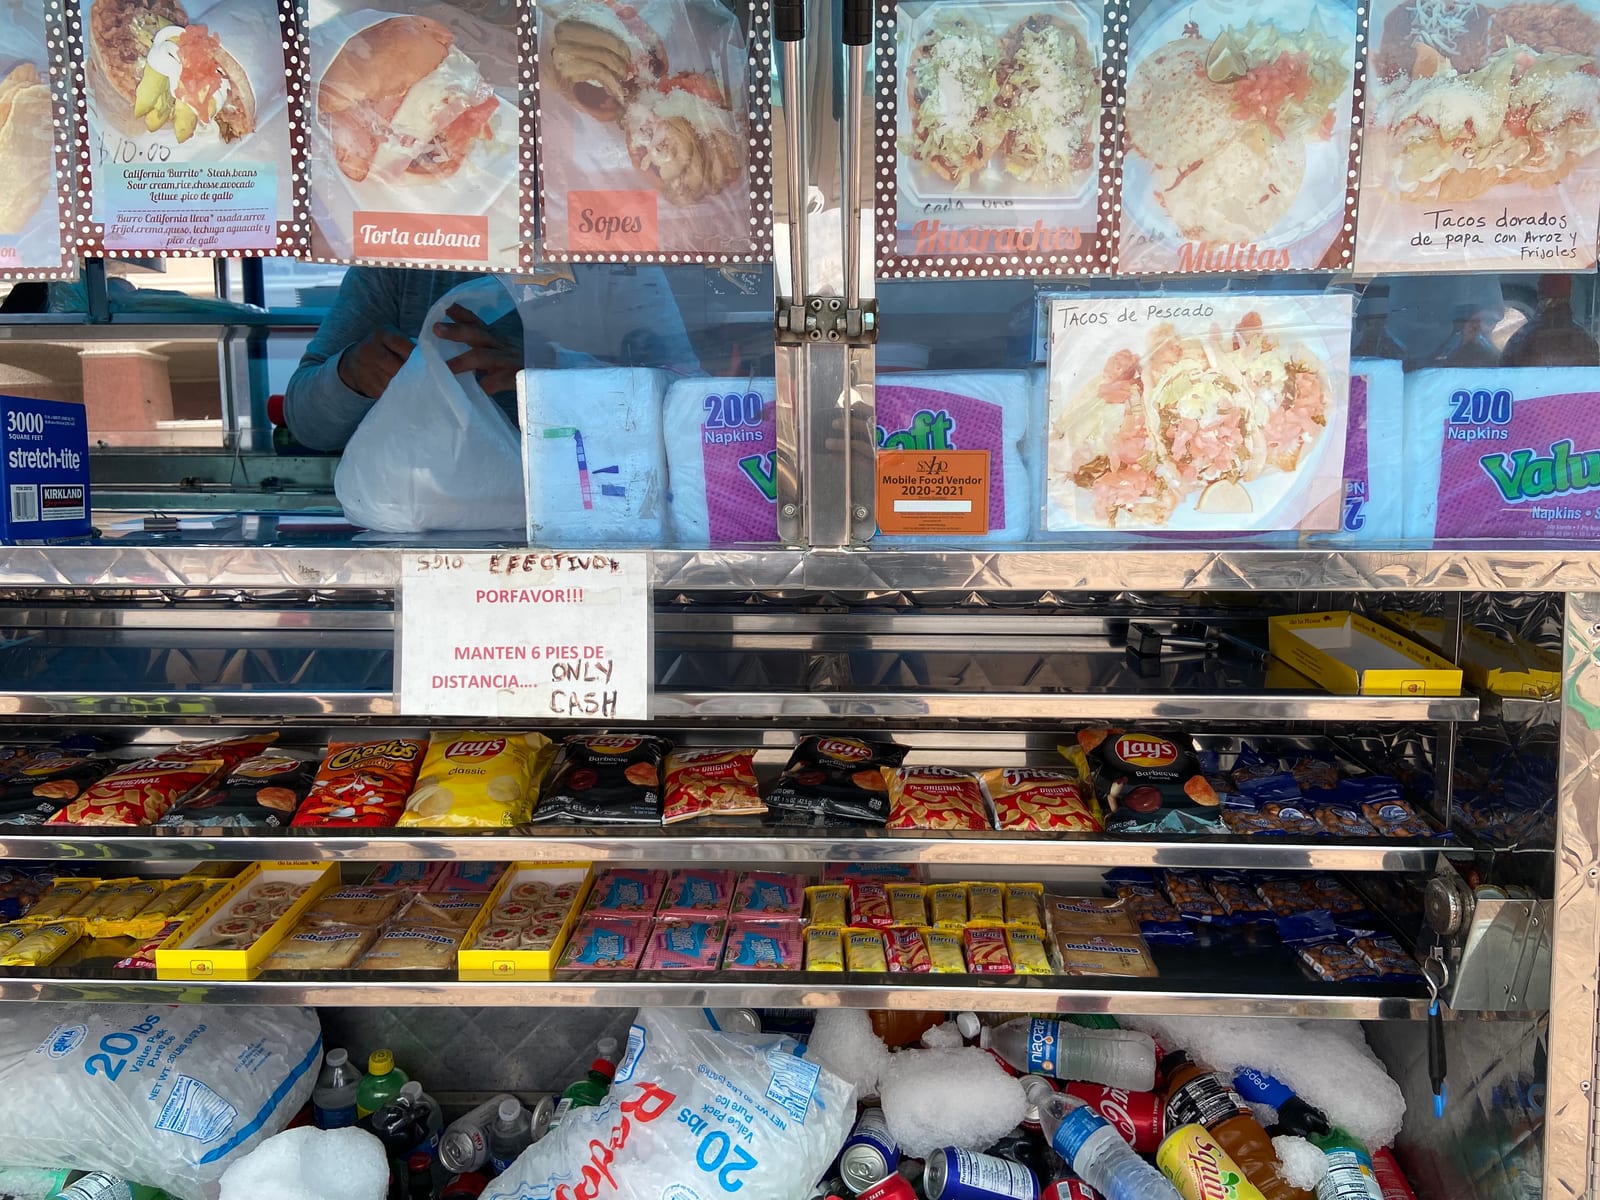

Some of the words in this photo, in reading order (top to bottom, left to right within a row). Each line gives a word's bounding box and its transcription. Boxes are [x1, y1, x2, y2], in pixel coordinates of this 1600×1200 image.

[123, 169, 166, 181] California
[127, 180, 147, 190] Sour
[200, 192, 210, 200] de
[212, 191, 234, 203] gallo
[116, 214, 144, 223] Burro
[145, 213, 188, 225] California
[577, 209, 643, 236] Sopes
[1424, 209, 1487, 230] Tacos
[1495, 207, 1568, 229] dorados
[193, 225, 224, 235] lechuga
[265, 224, 271, 234] y
[360, 224, 409, 248] Torta
[413, 227, 481, 249] cubana
[911, 218, 1083, 254] Huaraches
[166, 236, 184, 246] pico
[186, 236, 197, 245] de
[198, 235, 219, 247] gallo
[1410, 232, 1434, 247] de
[1445, 234, 1484, 249] papa
[1494, 232, 1517, 243] con
[1524, 231, 1563, 243] Arroz
[1176, 241, 1291, 273] Mulitas
[1520, 246, 1578, 260] Frijoles
[1117, 305, 1144, 324] de
[1147, 302, 1215, 323] Pescado
[703, 391, 764, 429] 200
[1448, 388, 1514, 425] 200
[7, 410, 44, 434] 3000
[704, 429, 763, 445] Napkins
[1447, 427, 1509, 441] Napkins
[8, 447, 81, 470] stretch-tite
[882, 476, 916, 485] Mobile
[919, 476, 943, 485] Food
[946, 476, 982, 485] Vendor
[44, 488, 82, 499] KIRKLAND
[901, 486, 963, 496] 2020-2021
[1532, 506, 1582, 521] Napkins
[476, 588, 585, 604] PORFAVOR!!!
[453, 646, 527, 661] MANTEN
[531, 646, 541, 660] 6
[545, 645, 579, 660] PIES
[583, 645, 605, 660] DE
[550, 658, 614, 685] ONLY
[550, 689, 619, 718] CASH
[331, 740, 420, 769] Cheetos
[448, 738, 504, 758] Lay's
[1122, 740, 1173, 758] Lay's
[701, 761, 741, 773] ORIGINAL
[385, 931, 455, 945] Rebanadas
[1066, 943, 1139, 954] Rebanadas
[84, 1032, 139, 1082] 20
[128, 1014, 161, 1035] lbs
[147, 1043, 164, 1068] Pure
[129, 1045, 153, 1073] Value
[1243, 1067, 1271, 1091] peps
[148, 1083, 163, 1101] NET
[715, 1094, 730, 1108] Ice
[158, 1093, 179, 1128] Nutrition
[701, 1103, 727, 1122] Pack
[731, 1103, 754, 1124] Pure
[677, 1108, 709, 1137] lbs
[769, 1114, 788, 1131] NET
[695, 1130, 759, 1193] 20
[1188, 1136, 1229, 1200] Squi
